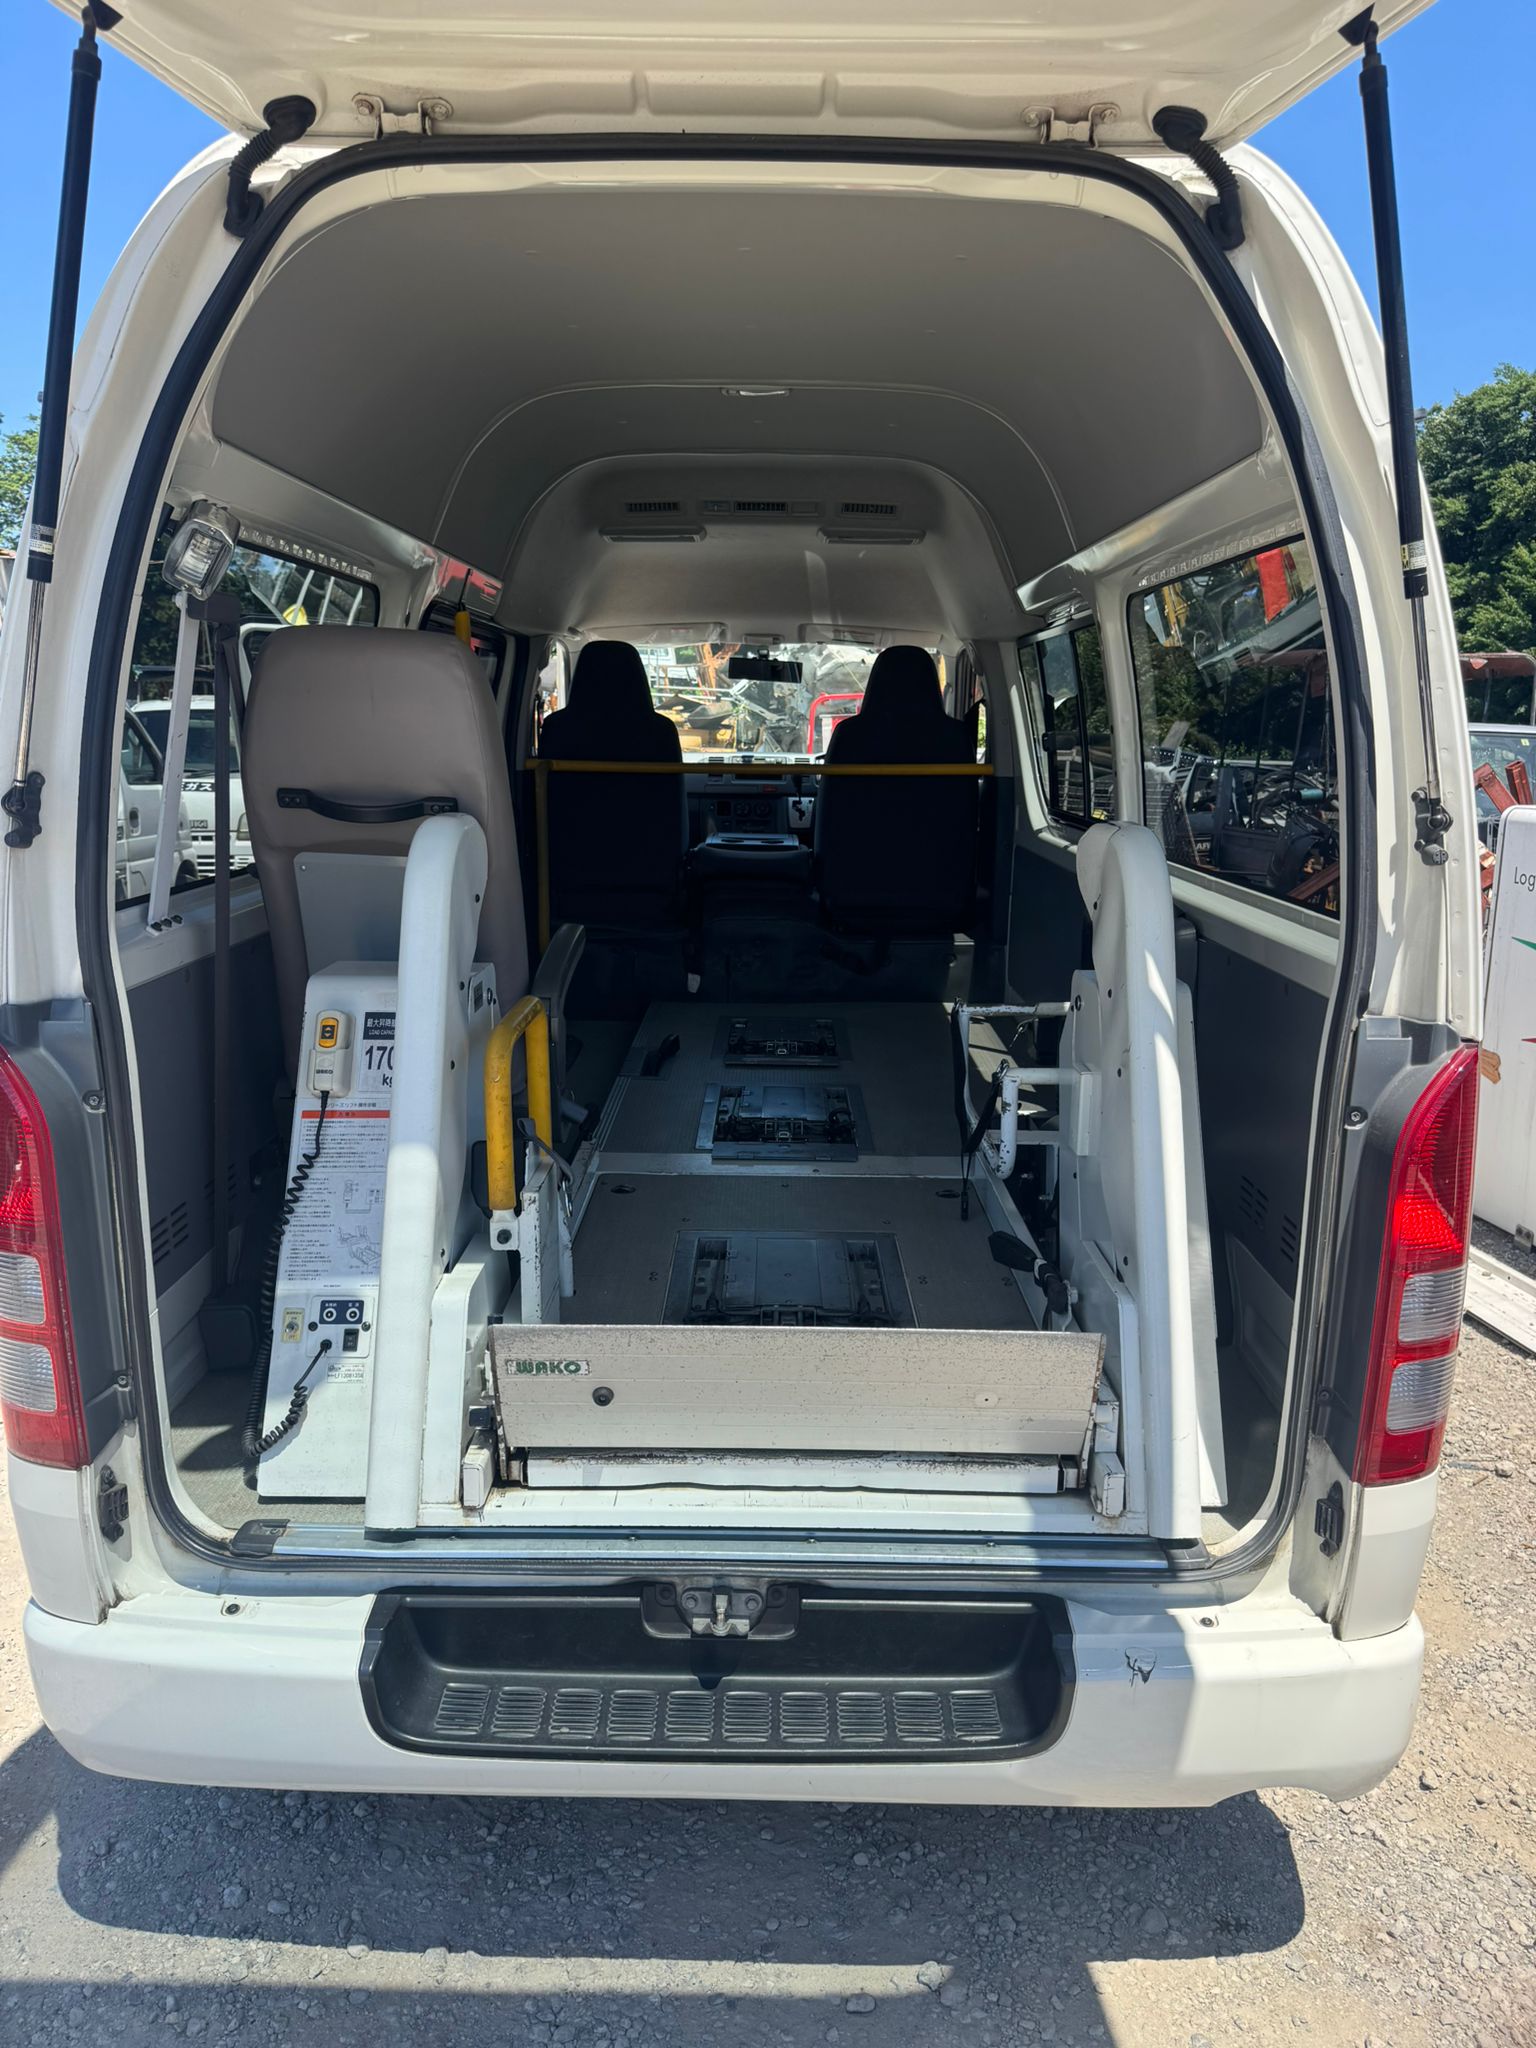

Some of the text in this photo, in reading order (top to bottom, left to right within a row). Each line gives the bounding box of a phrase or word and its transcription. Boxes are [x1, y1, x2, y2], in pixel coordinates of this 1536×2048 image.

[181, 782, 213, 791] ガス
[1514, 866, 1536, 891] Log
[515, 1360, 582, 1375] WAKO
